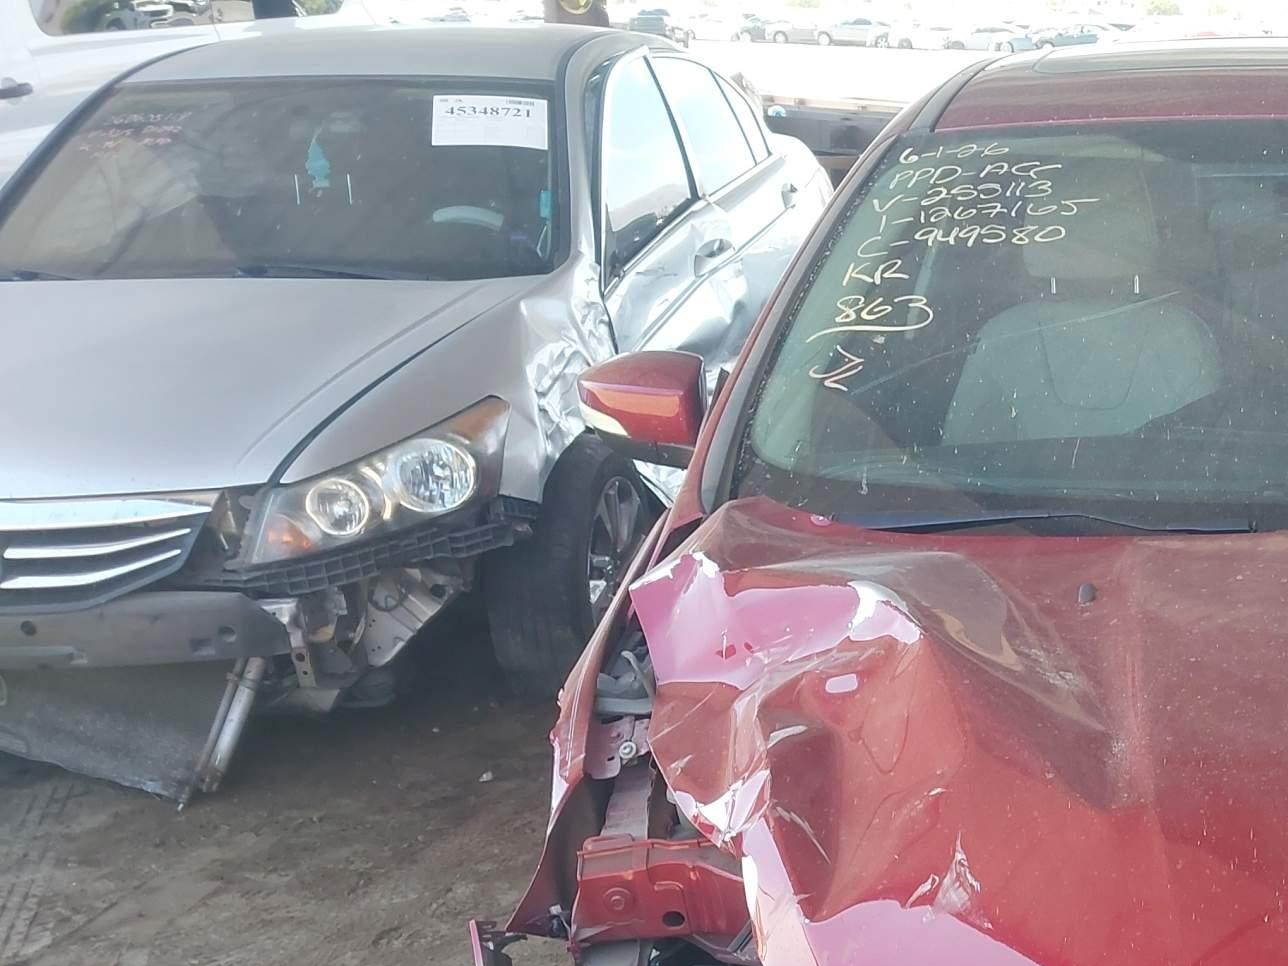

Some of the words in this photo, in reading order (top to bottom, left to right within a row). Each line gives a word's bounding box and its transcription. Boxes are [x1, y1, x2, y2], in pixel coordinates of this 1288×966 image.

[445, 106, 531, 118] 45348721
[900, 142, 1010, 164] 6-1-26
[842, 259, 910, 286] KR
[824, 295, 934, 333] 863
